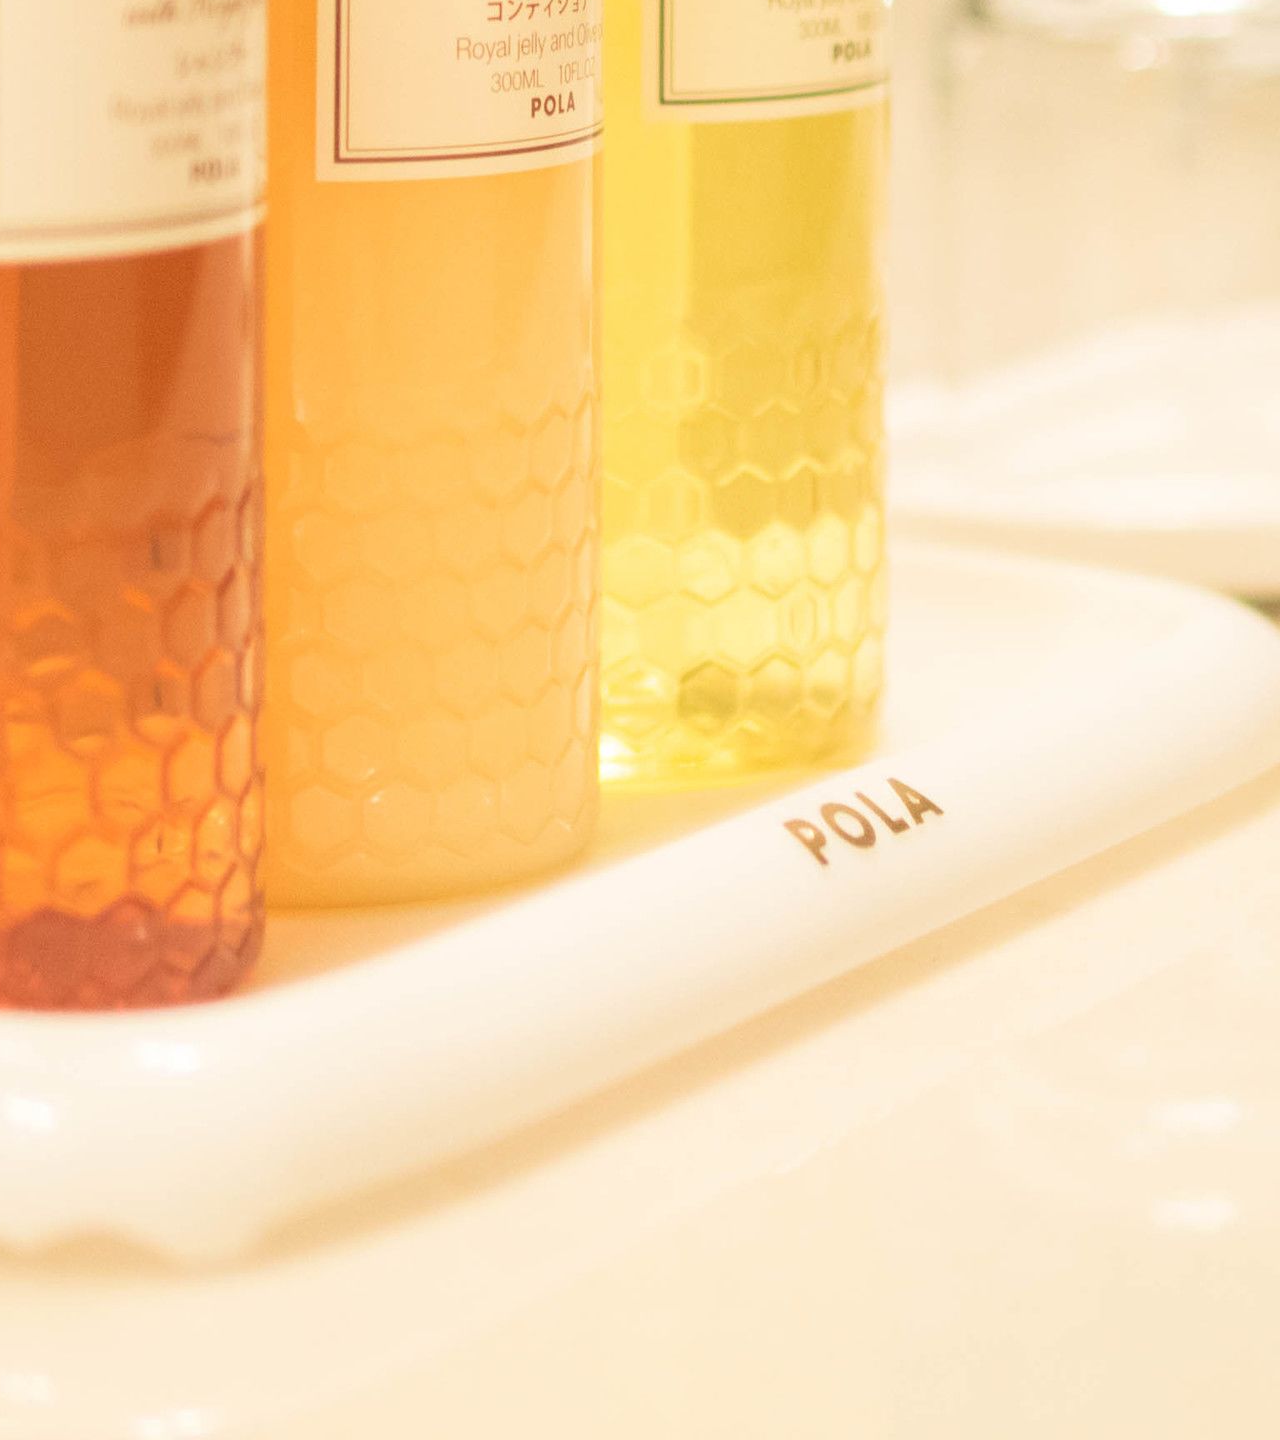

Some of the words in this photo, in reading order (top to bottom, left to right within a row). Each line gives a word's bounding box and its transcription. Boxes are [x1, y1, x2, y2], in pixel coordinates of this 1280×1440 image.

[455, 35, 511, 66] Royal
[516, 31, 546, 63] jelly
[550, 25, 575, 53] and
[489, 68, 545, 93] 300ML
[530, 90, 577, 119] POLA
[783, 777, 944, 865] POLA
